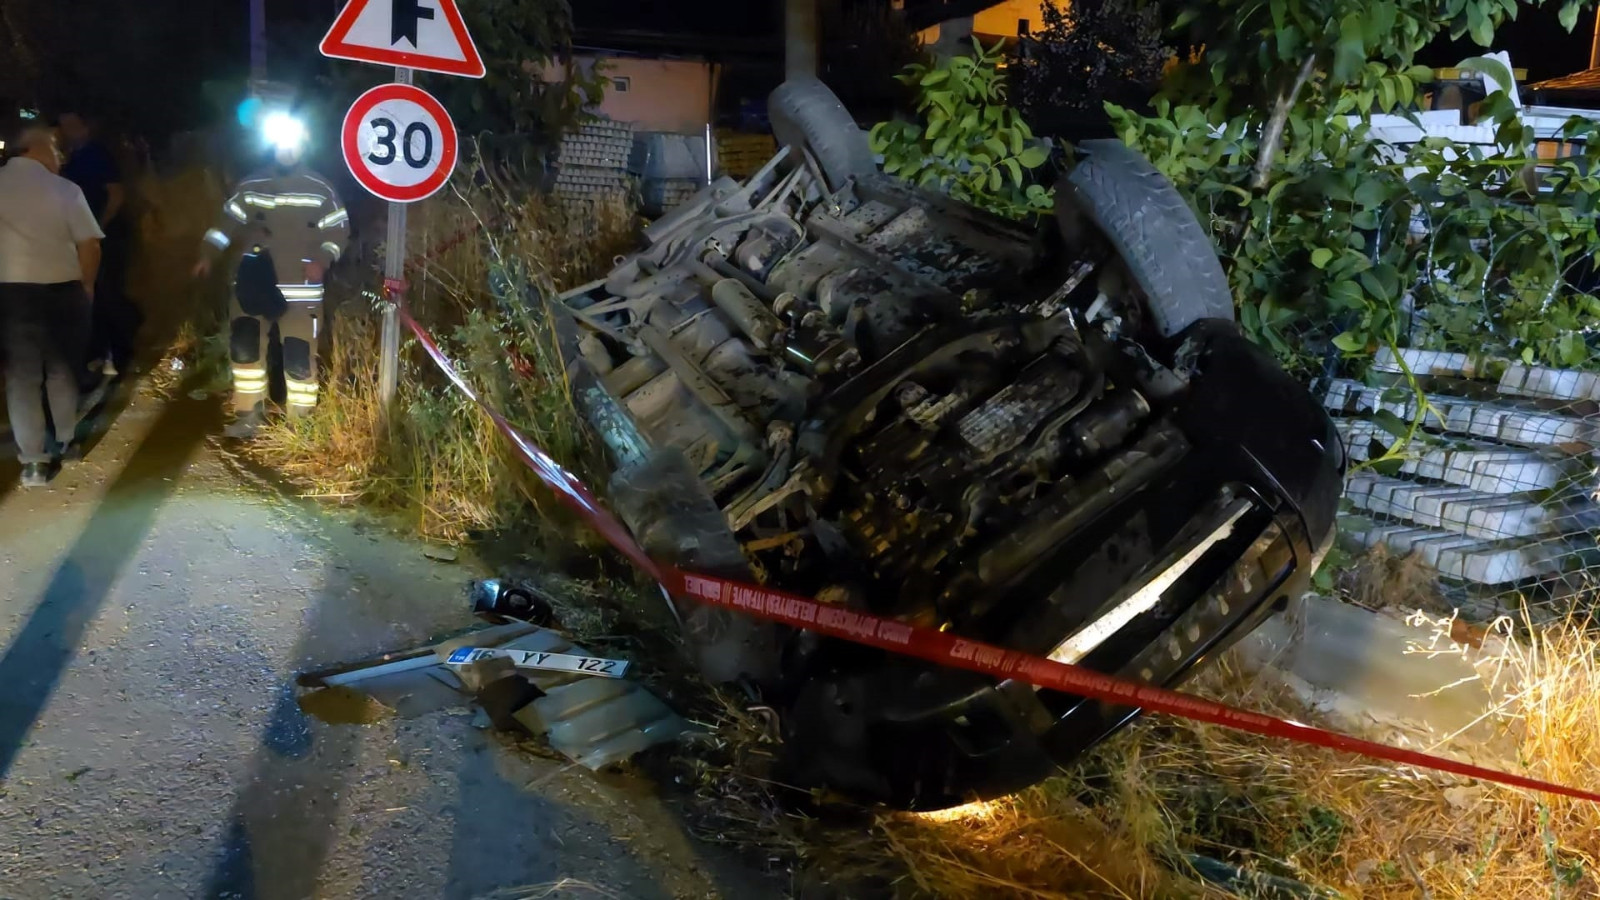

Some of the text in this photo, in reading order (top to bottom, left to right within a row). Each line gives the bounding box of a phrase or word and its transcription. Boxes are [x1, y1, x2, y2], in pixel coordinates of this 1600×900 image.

[368, 117, 433, 169] 30
[521, 652, 550, 665] YY
[577, 658, 618, 673] 122
